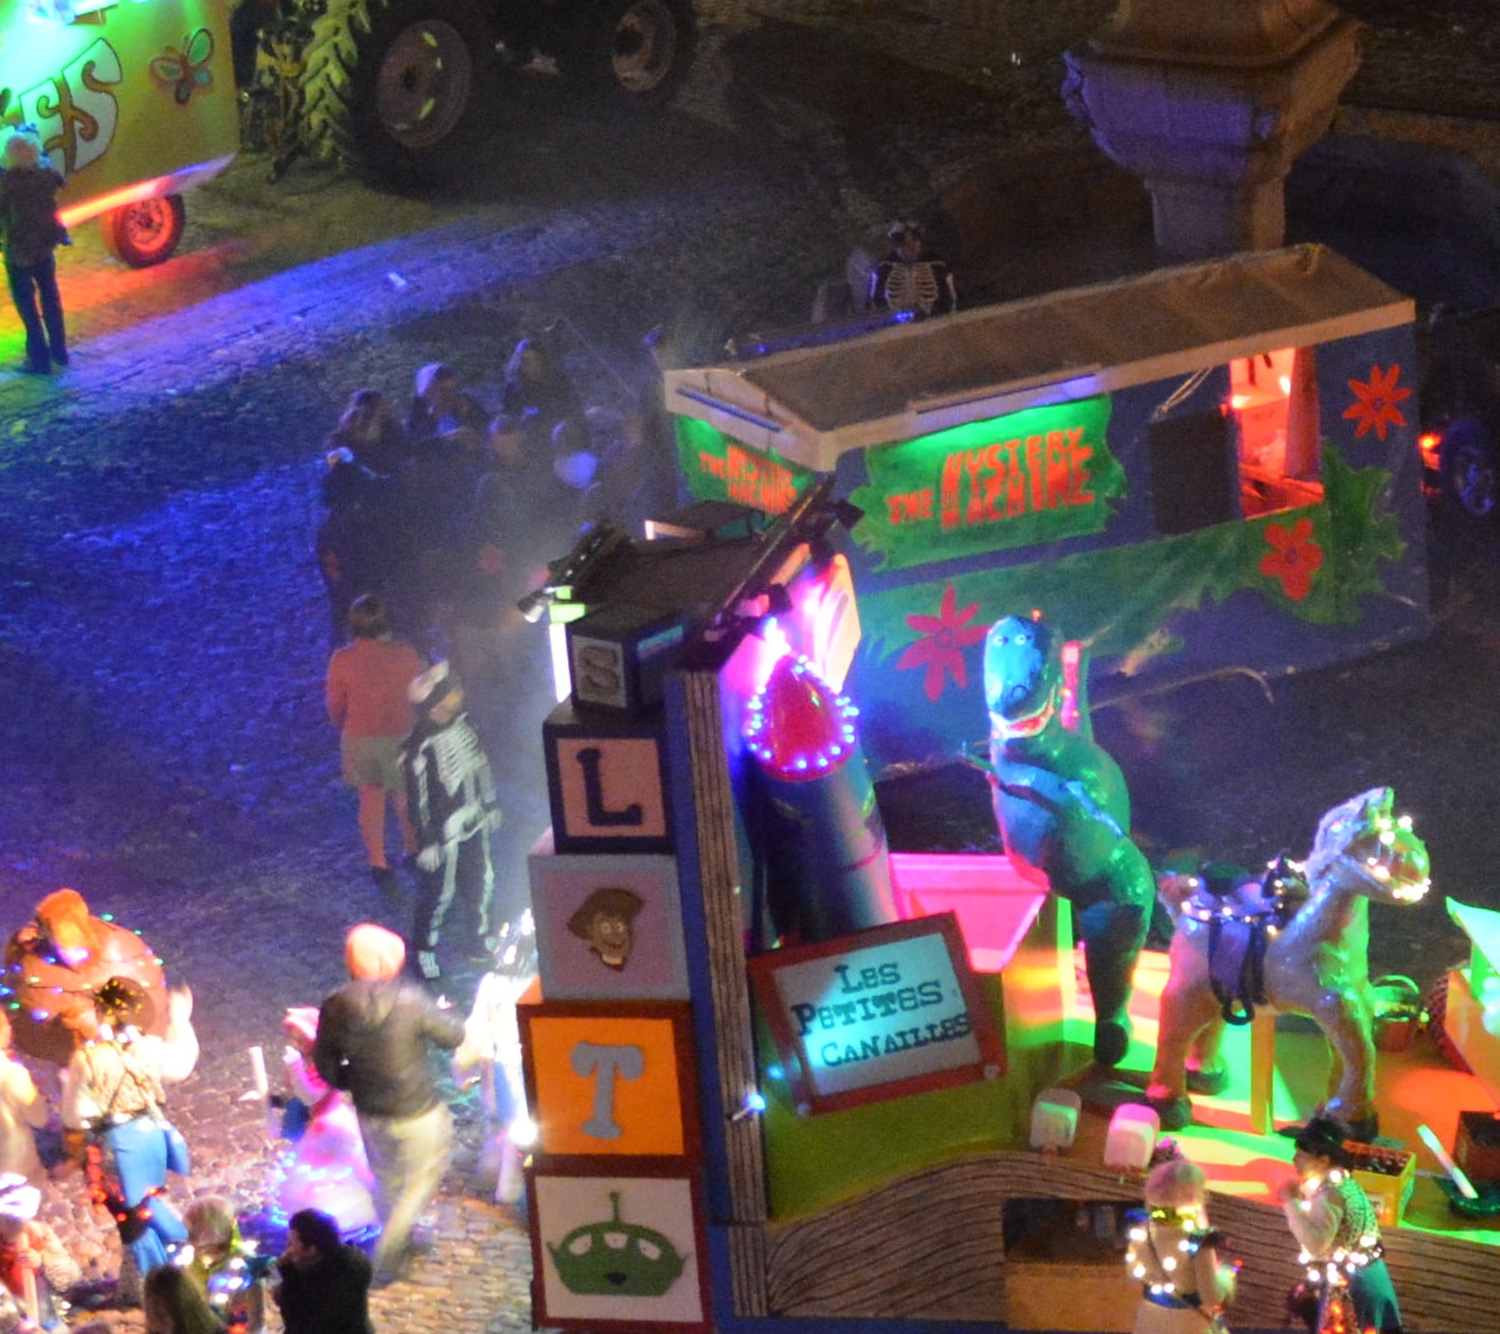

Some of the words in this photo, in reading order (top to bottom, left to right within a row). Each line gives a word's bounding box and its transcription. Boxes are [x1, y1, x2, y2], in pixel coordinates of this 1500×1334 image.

[887, 488, 933, 525] THE
[578, 646, 621, 698] S
[576, 748, 643, 826] L
[571, 1041, 645, 1140] T
